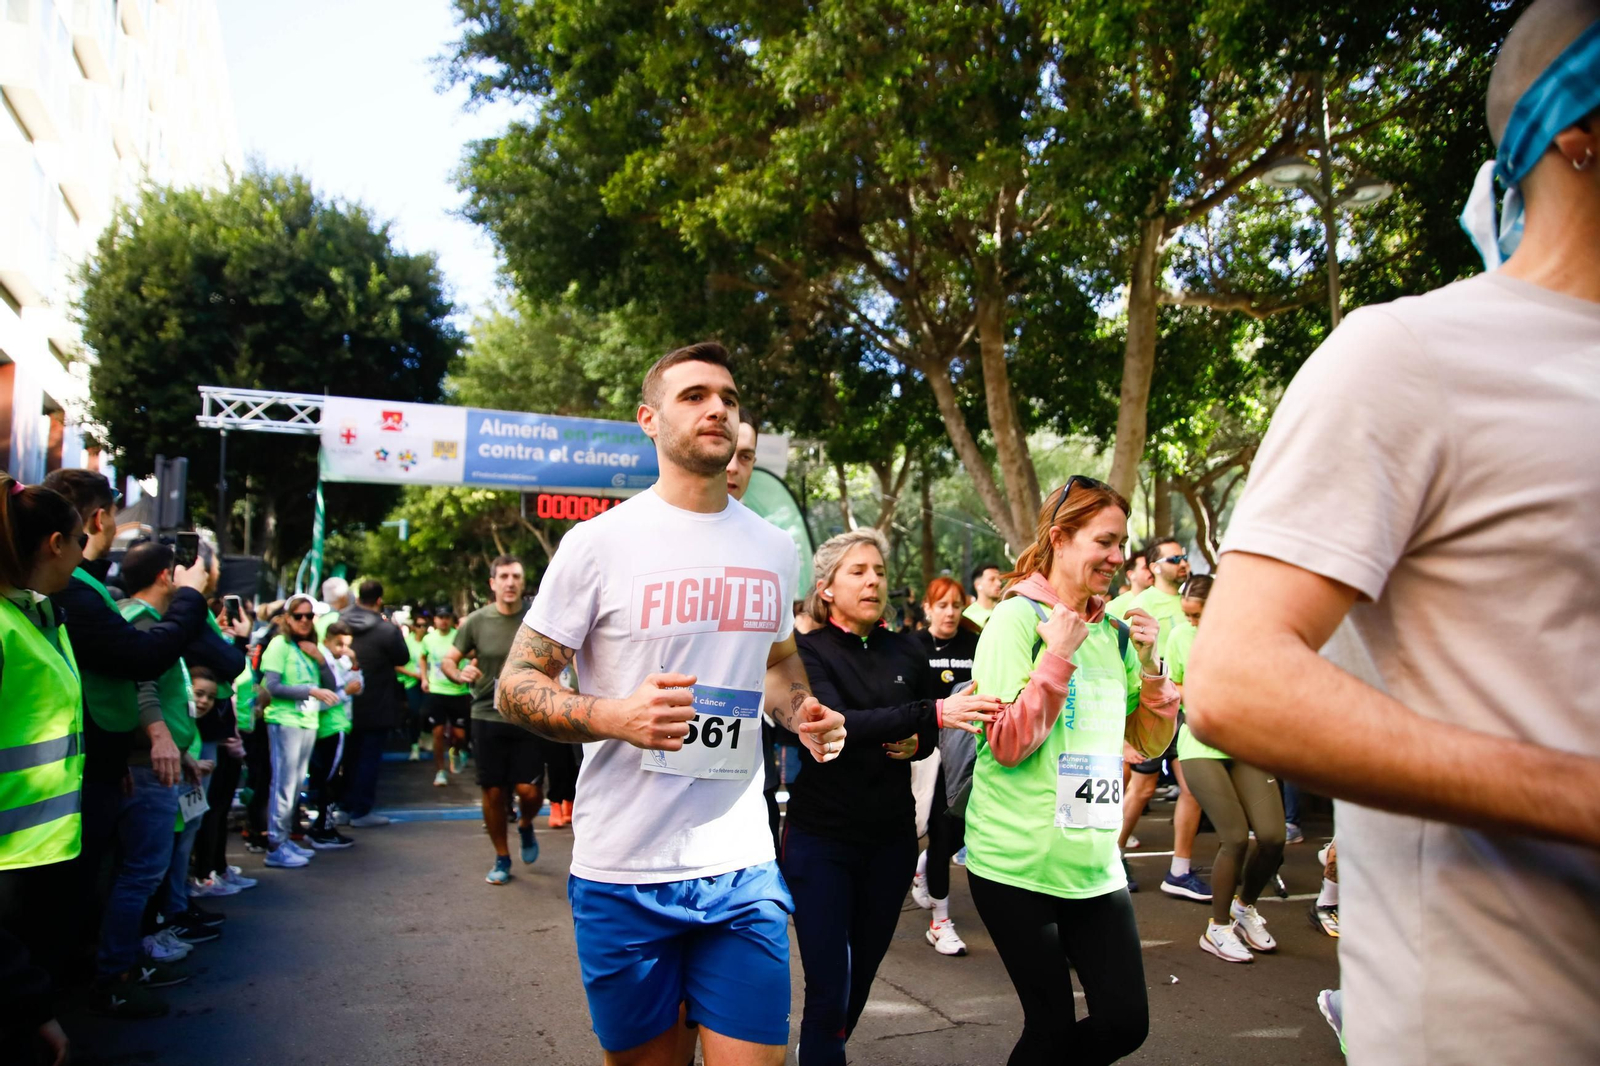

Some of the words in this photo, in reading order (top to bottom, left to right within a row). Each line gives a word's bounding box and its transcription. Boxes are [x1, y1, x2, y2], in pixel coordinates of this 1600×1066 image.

[480, 418, 558, 440] Almería
[563, 427, 587, 442] en
[479, 443, 544, 461] contra
[550, 446, 569, 463] el
[574, 449, 640, 467] cáncer
[640, 576, 777, 630] FIGHTER
[699, 698, 726, 708] cáncer
[1065, 674, 1076, 730] ALMER
[1075, 778, 1120, 804] 428
